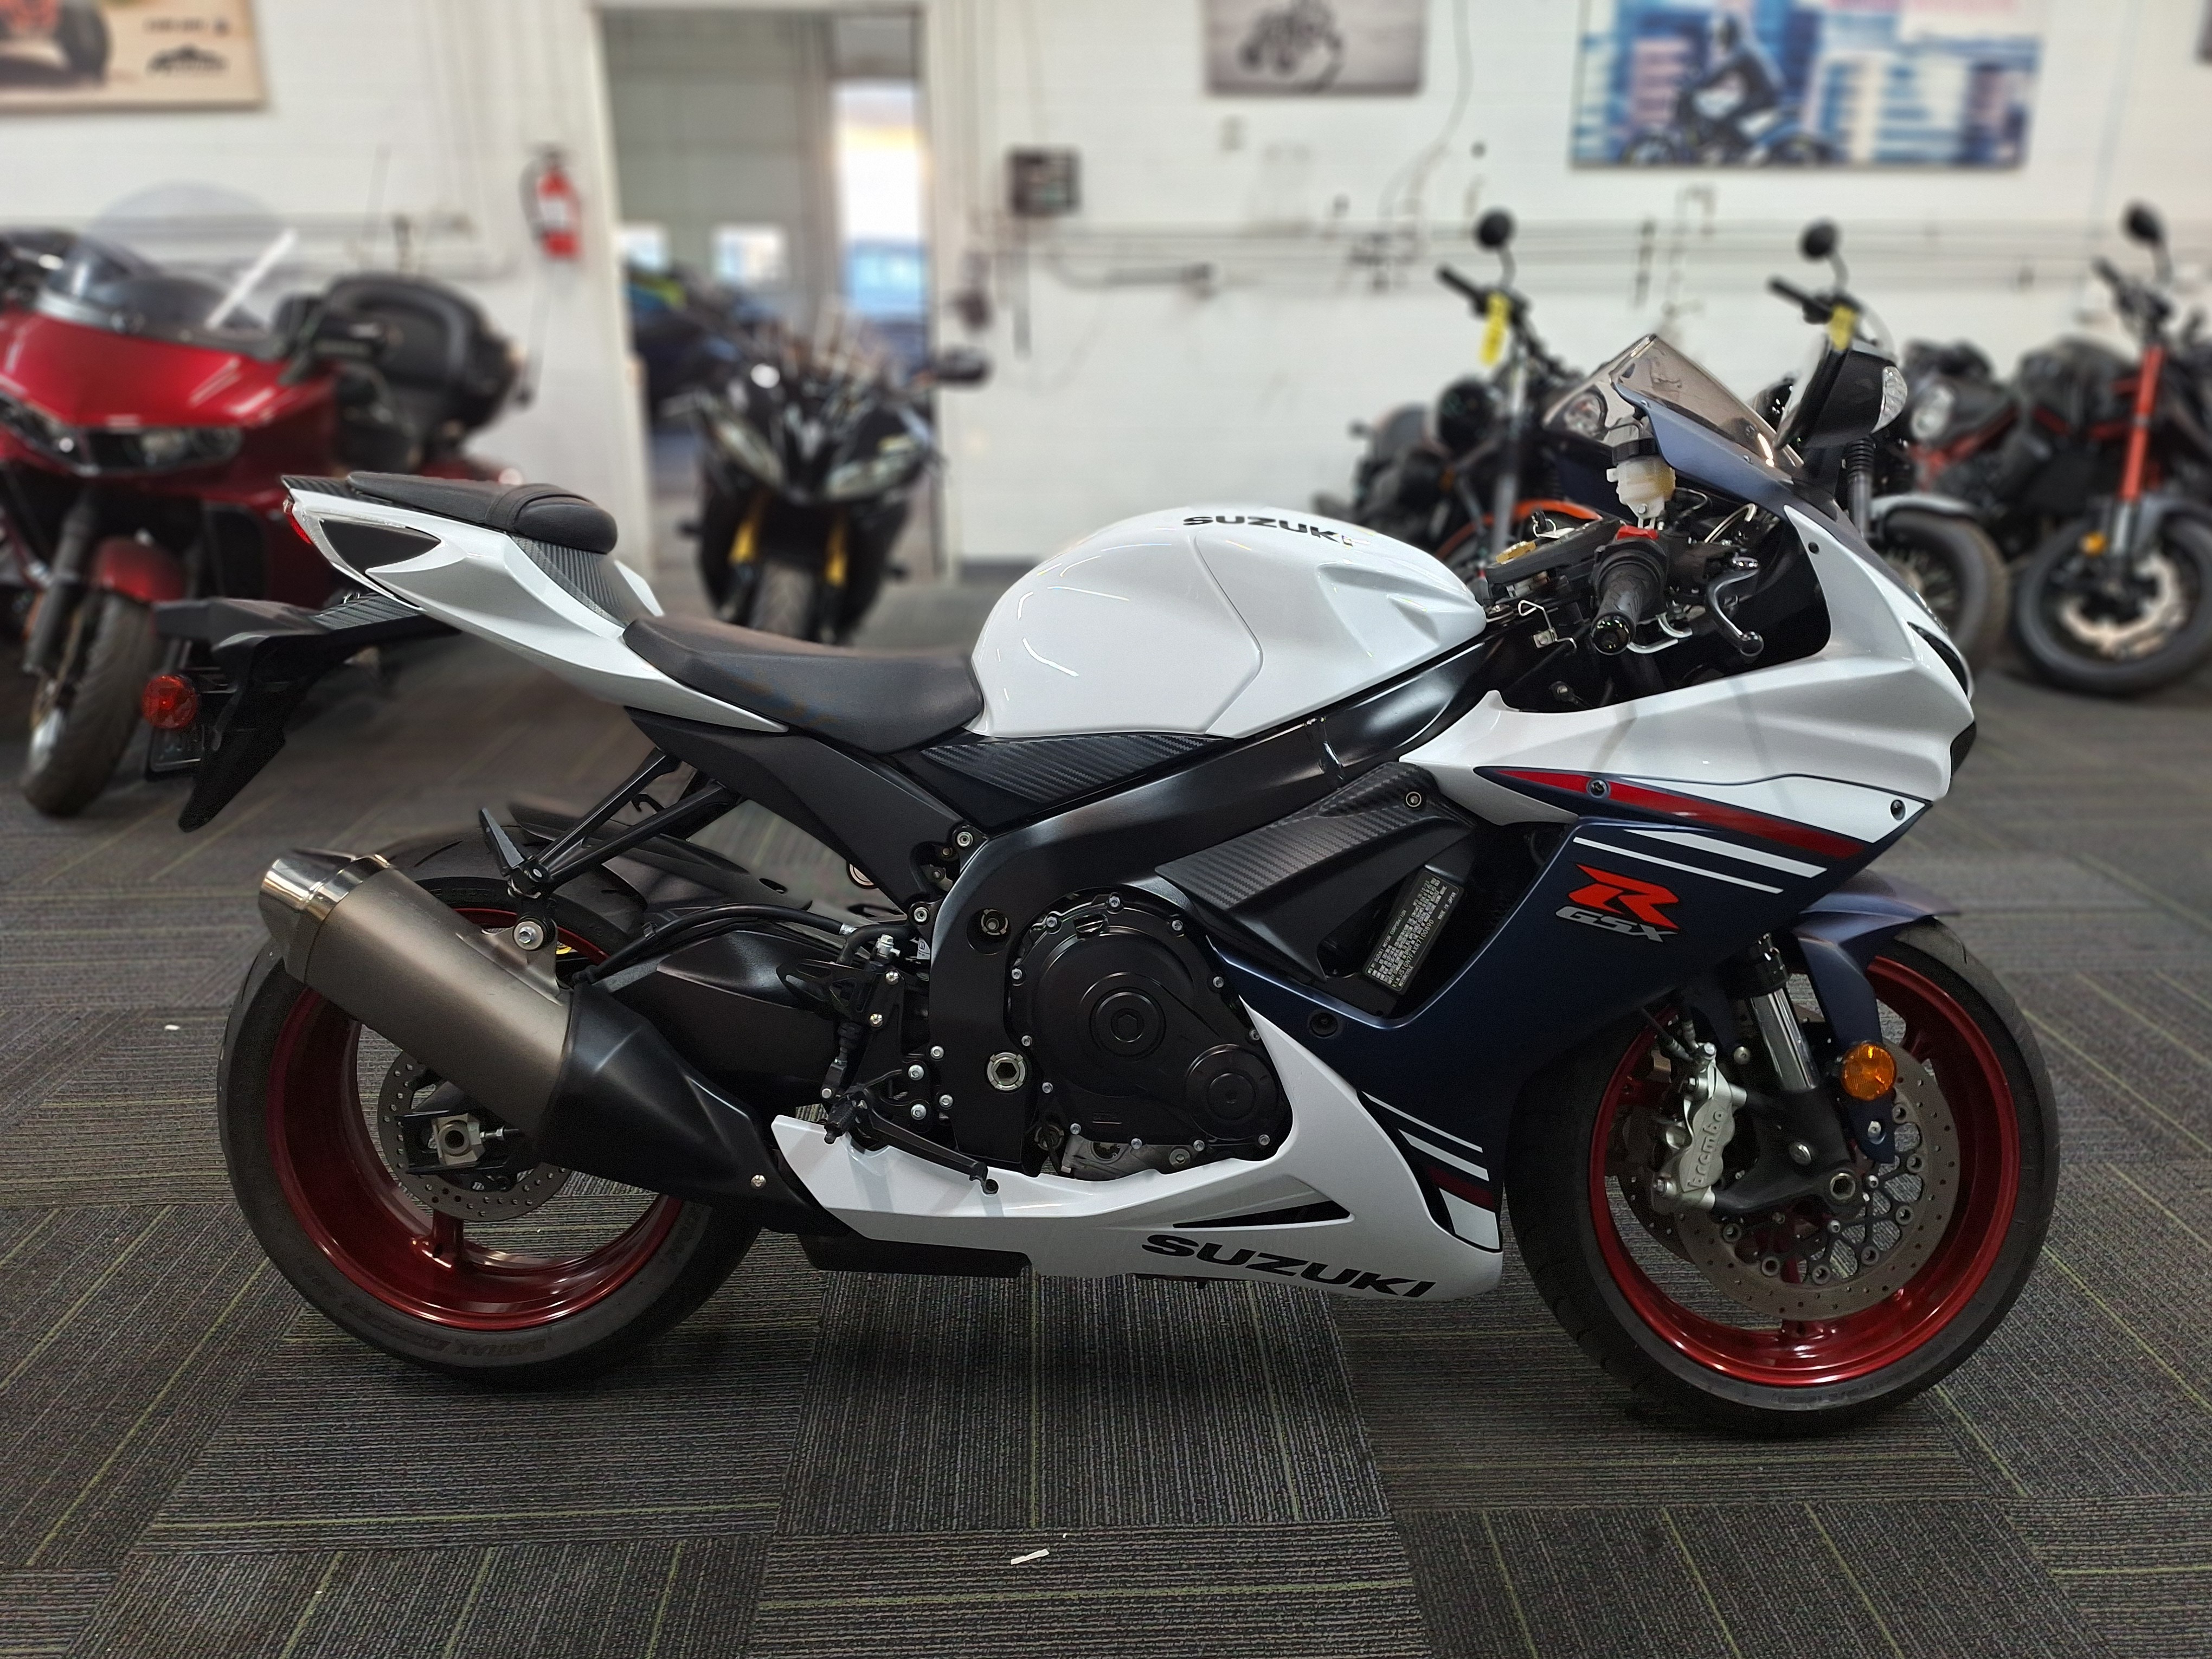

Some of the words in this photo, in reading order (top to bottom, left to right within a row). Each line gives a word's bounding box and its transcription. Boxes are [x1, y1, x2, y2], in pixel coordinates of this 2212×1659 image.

[1183, 516, 1354, 547] SUZUKI
[1568, 864, 1680, 929] R
[1555, 906, 1679, 942] GSX
[1142, 1234, 1436, 1297] SUZUKI
